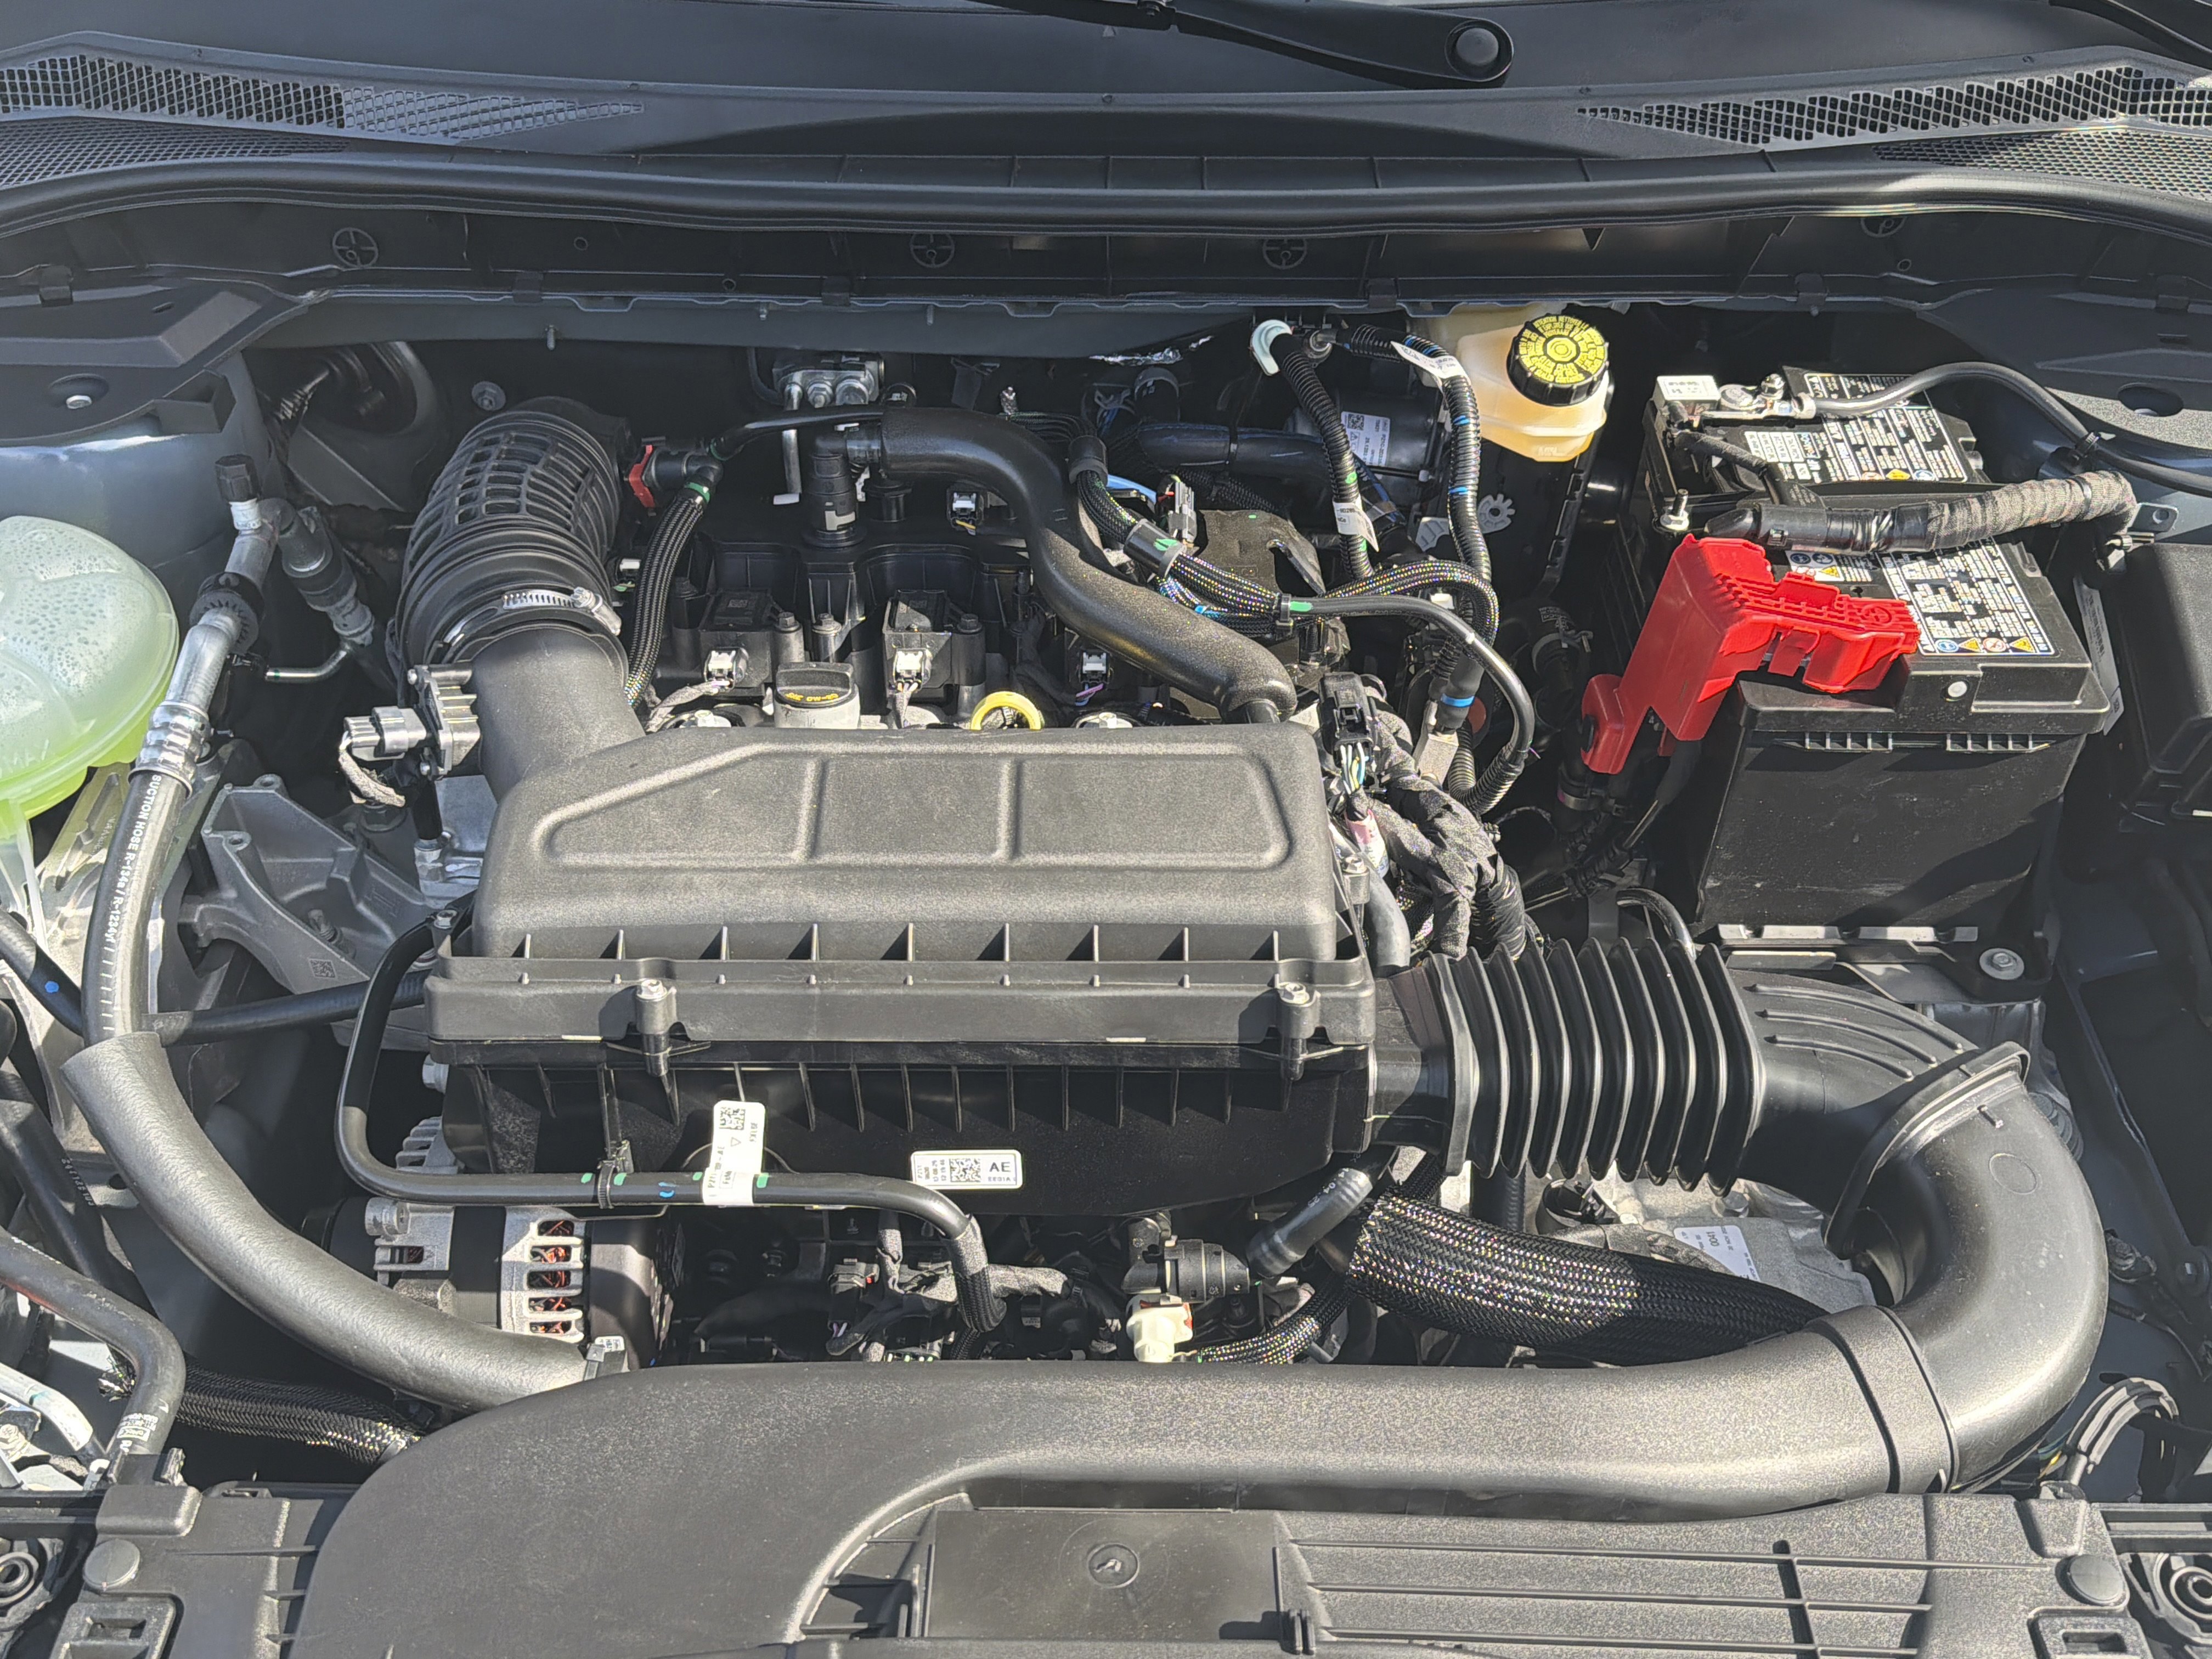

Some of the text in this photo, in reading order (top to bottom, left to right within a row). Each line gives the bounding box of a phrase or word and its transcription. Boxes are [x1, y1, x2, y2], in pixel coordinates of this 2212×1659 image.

[138, 775, 162, 820] SUCTION
[127, 821, 146, 851] HOSE
[117, 851, 136, 888] R-134a
[104, 896, 124, 943] R-1234yf
[989, 1161, 1011, 1172] AE
[1706, 1231, 1719, 1246] 0041
